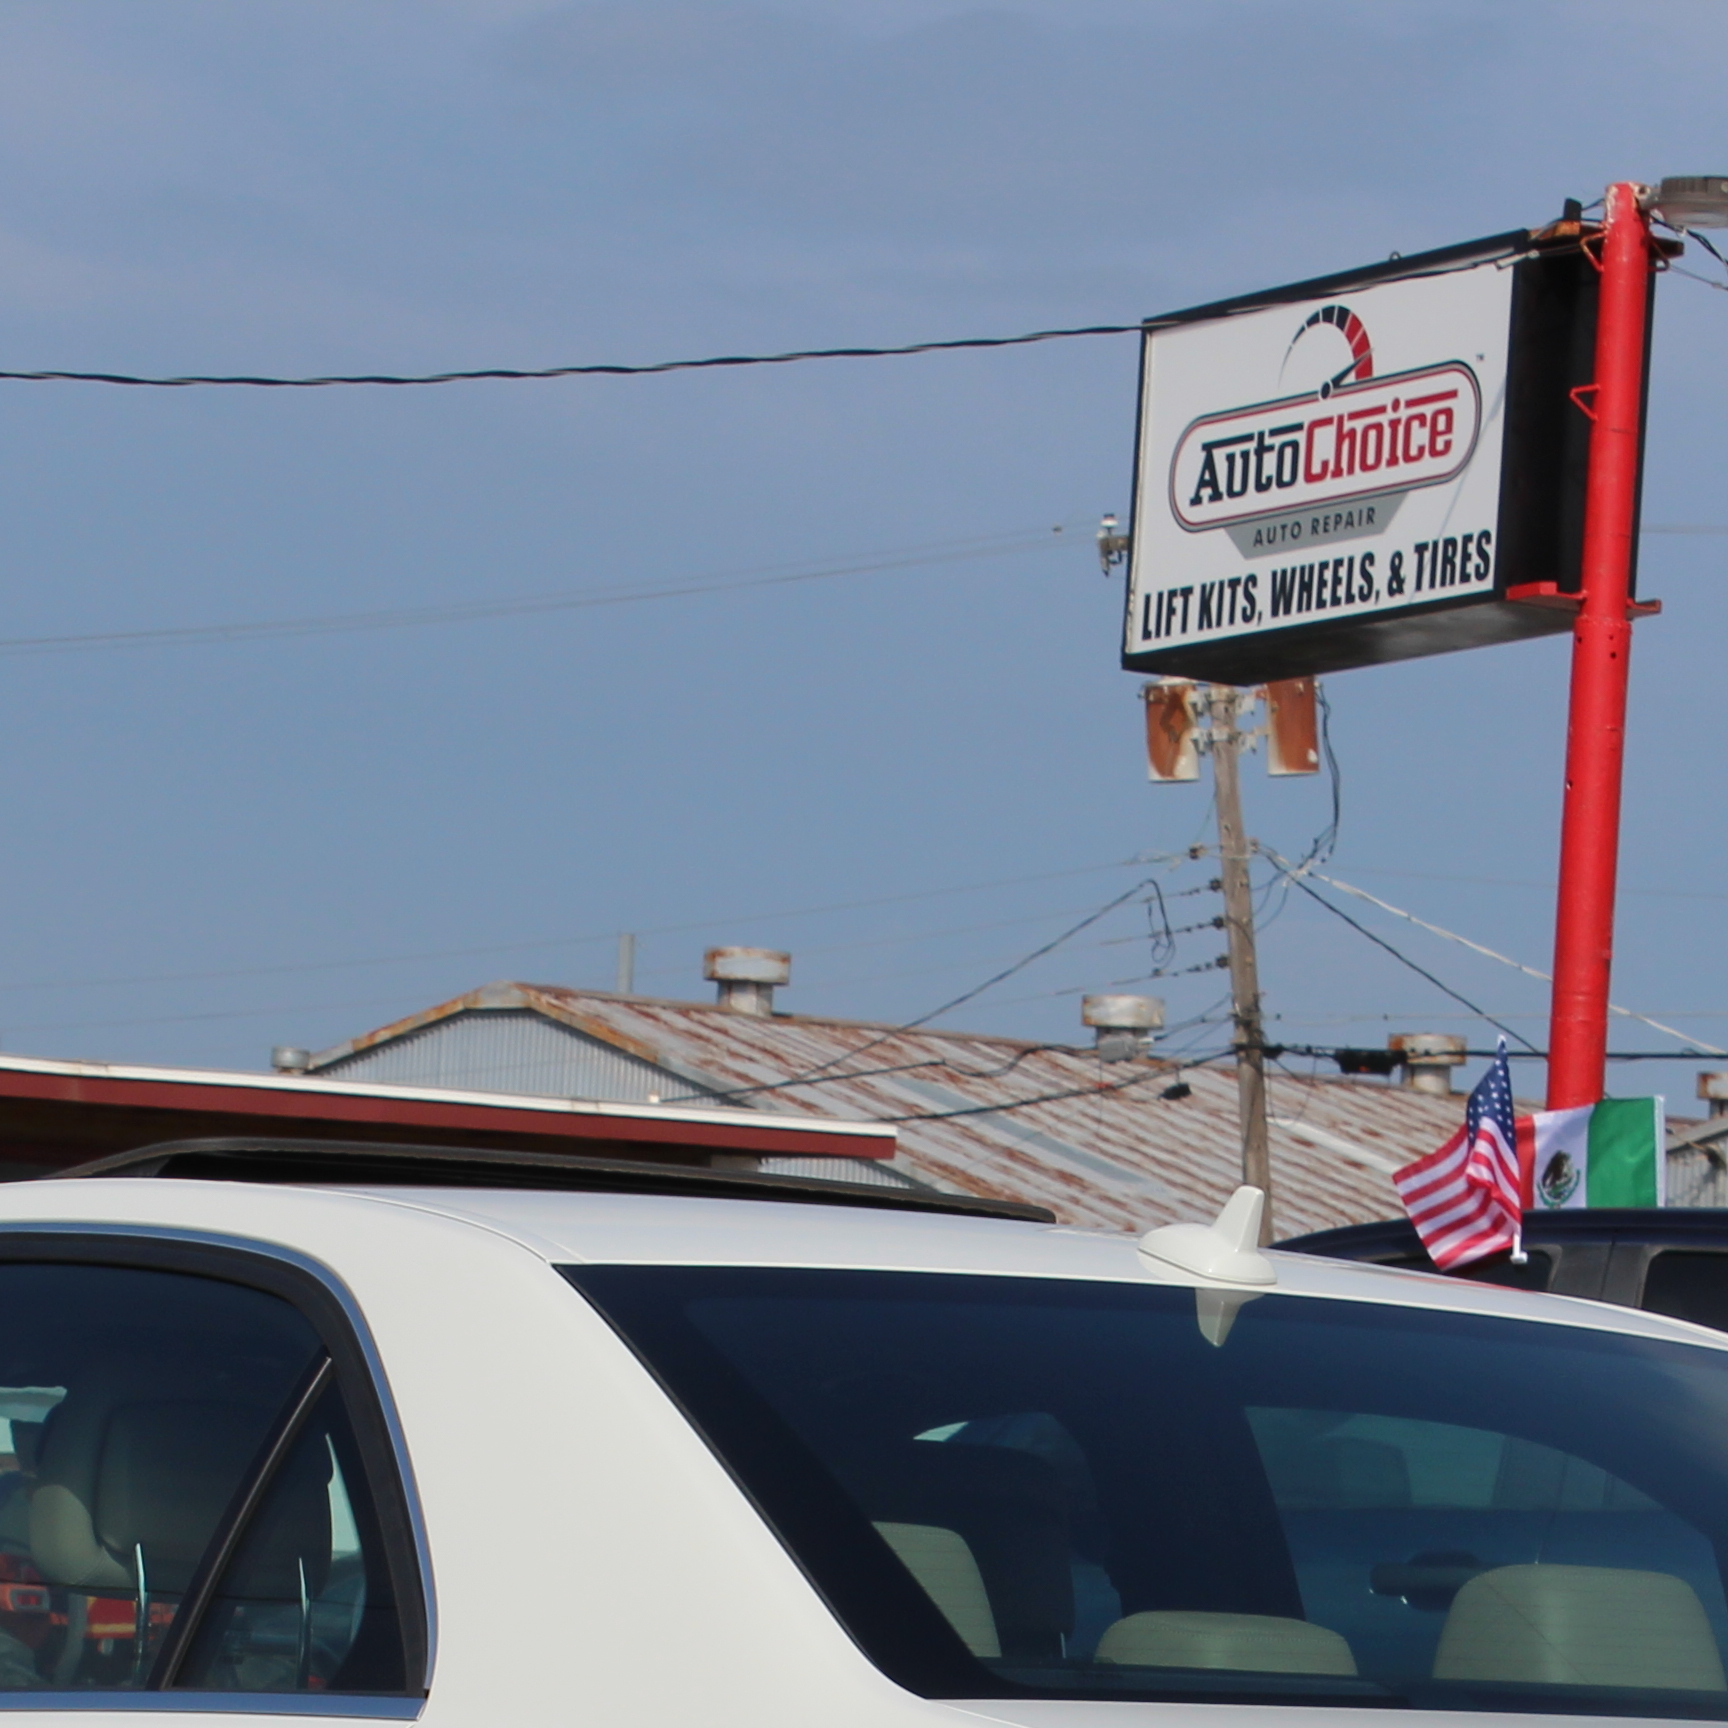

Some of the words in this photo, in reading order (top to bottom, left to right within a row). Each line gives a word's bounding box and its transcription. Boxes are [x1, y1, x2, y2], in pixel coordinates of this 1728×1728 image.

[1189, 389, 1459, 507] AutoChoice
[1253, 521, 1302, 548] AUTO
[1310, 506, 1376, 536] REPAIR
[1141, 585, 1194, 641] LIFT
[1197, 573, 1263, 631] KITS,
[1270, 551, 1380, 619] WHEELS,
[1387, 550, 1406, 598] &
[1414, 529, 1492, 592] TIRES
